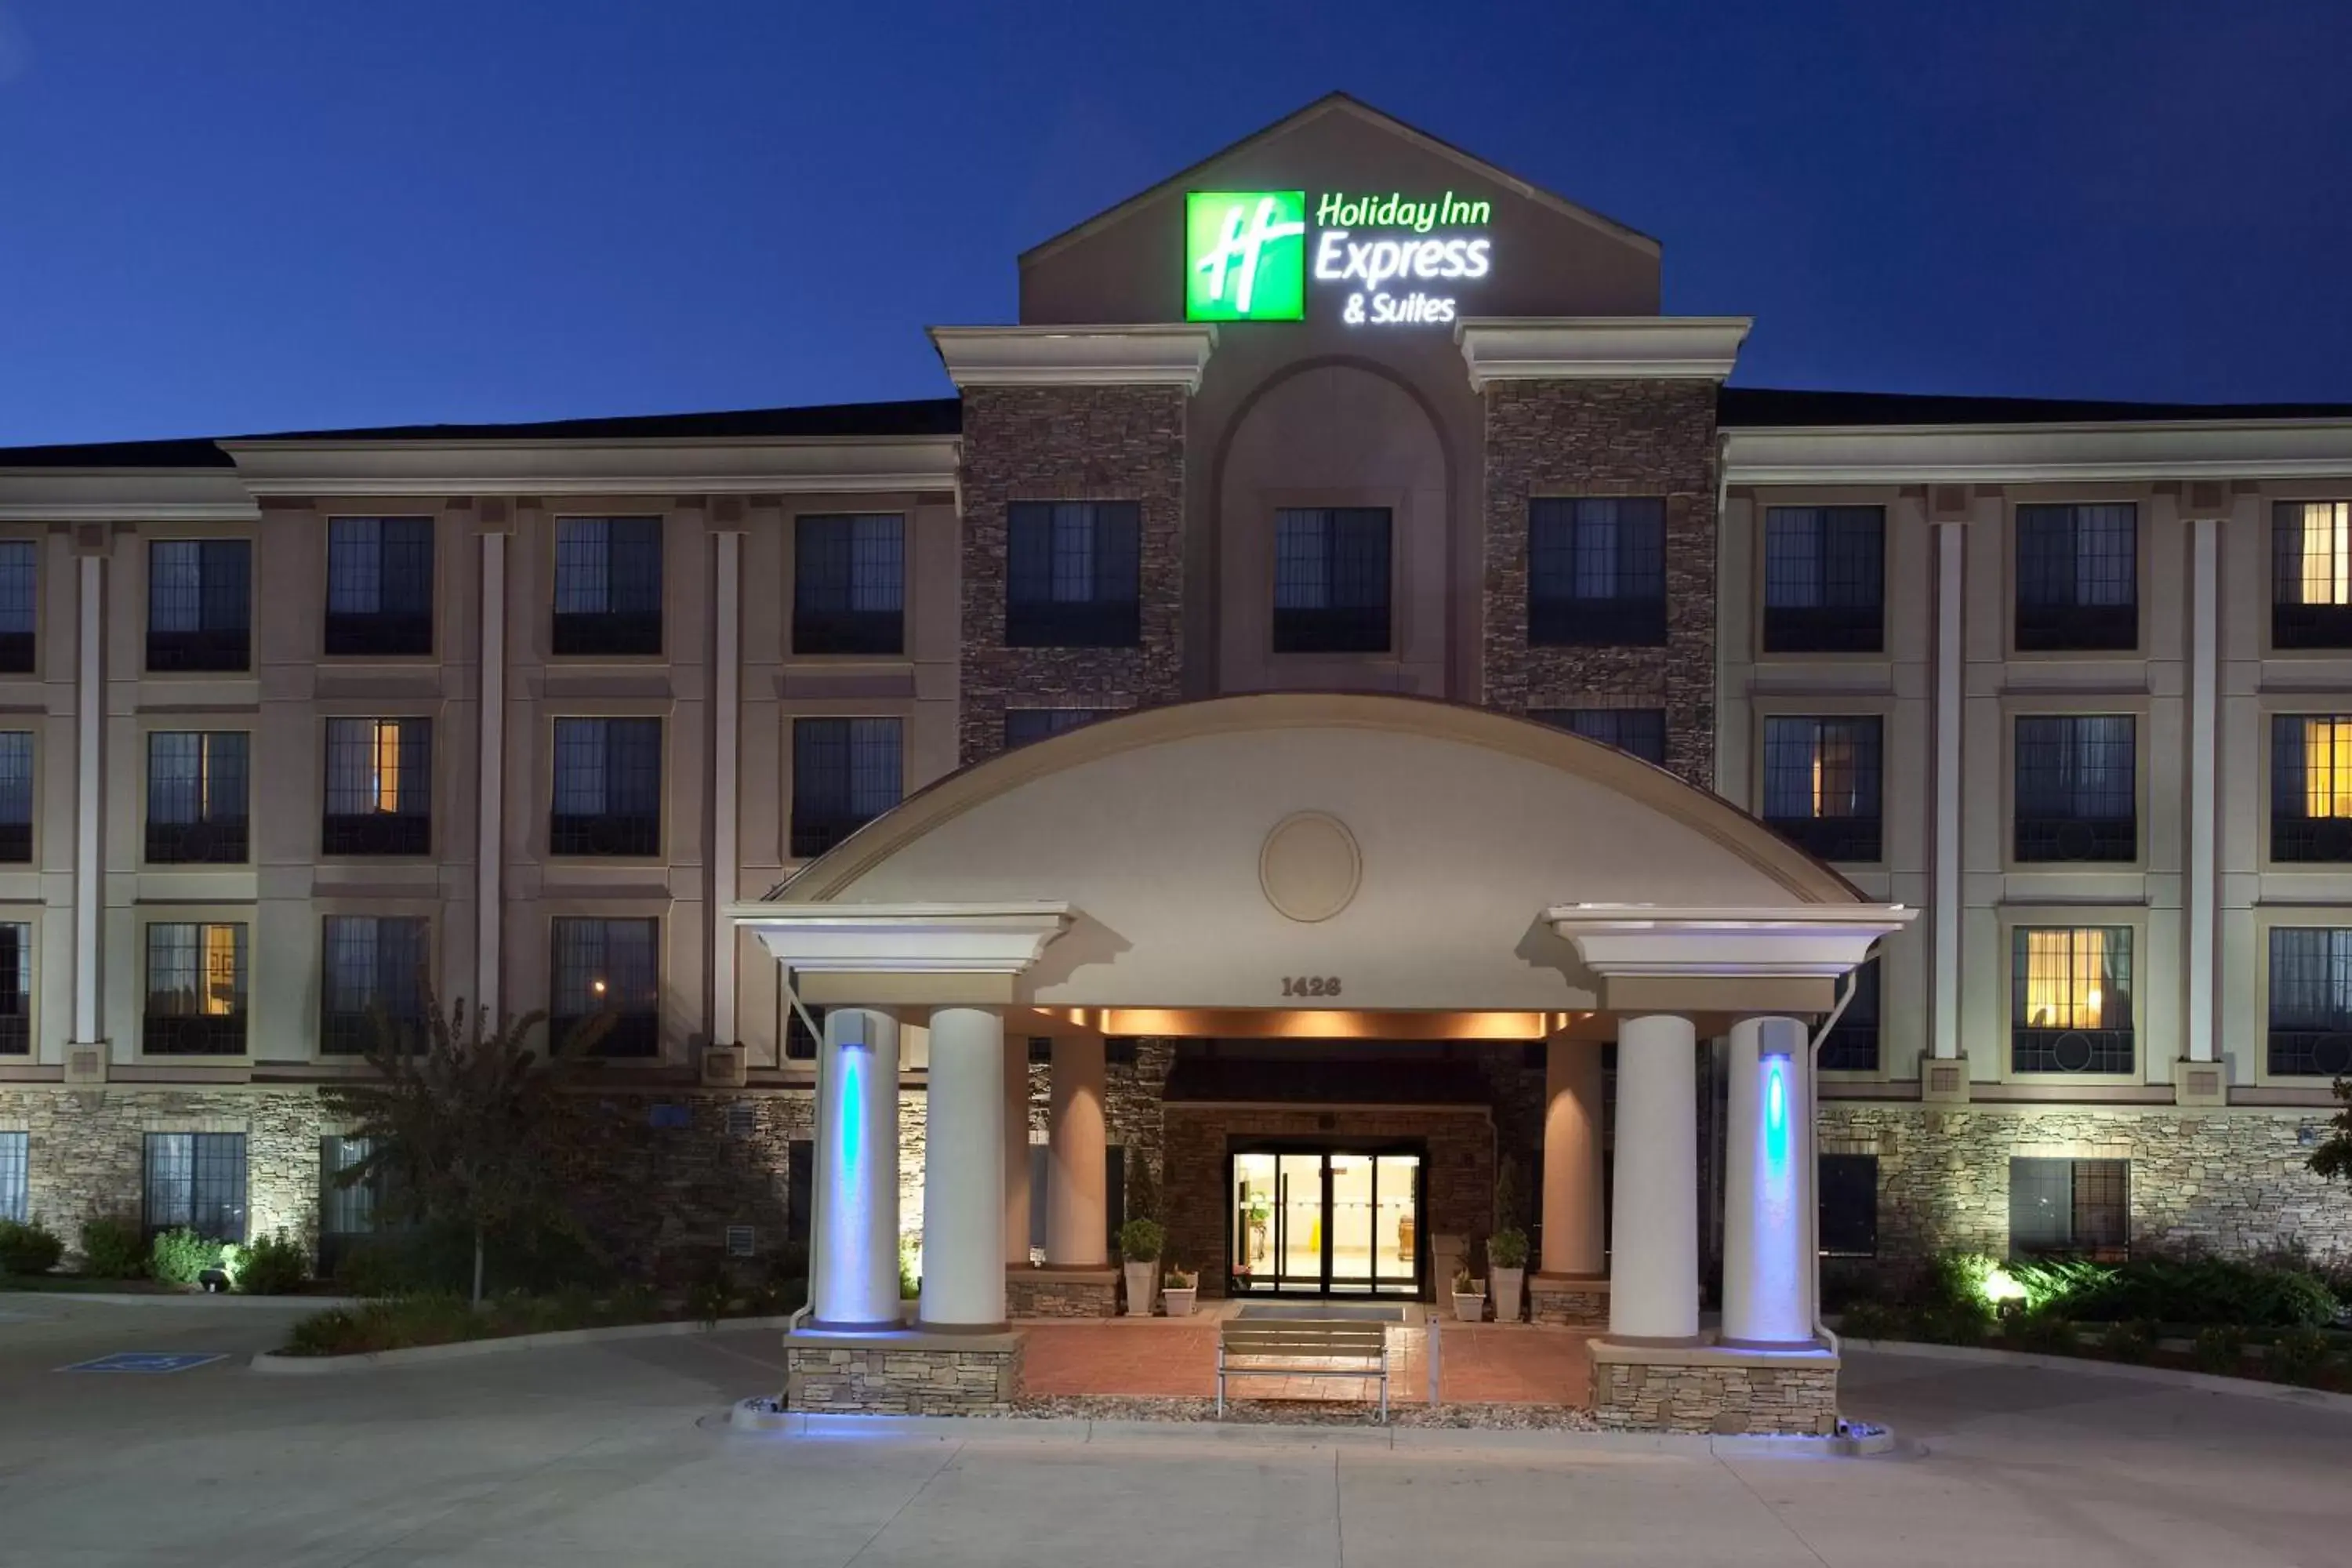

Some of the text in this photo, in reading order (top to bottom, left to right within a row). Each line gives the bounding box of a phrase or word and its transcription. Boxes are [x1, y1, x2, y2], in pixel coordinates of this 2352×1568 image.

[1316, 191, 1489, 232] Holiday Inn
[1315, 231, 1490, 290] Express
[1343, 292, 1456, 325] & Suites
